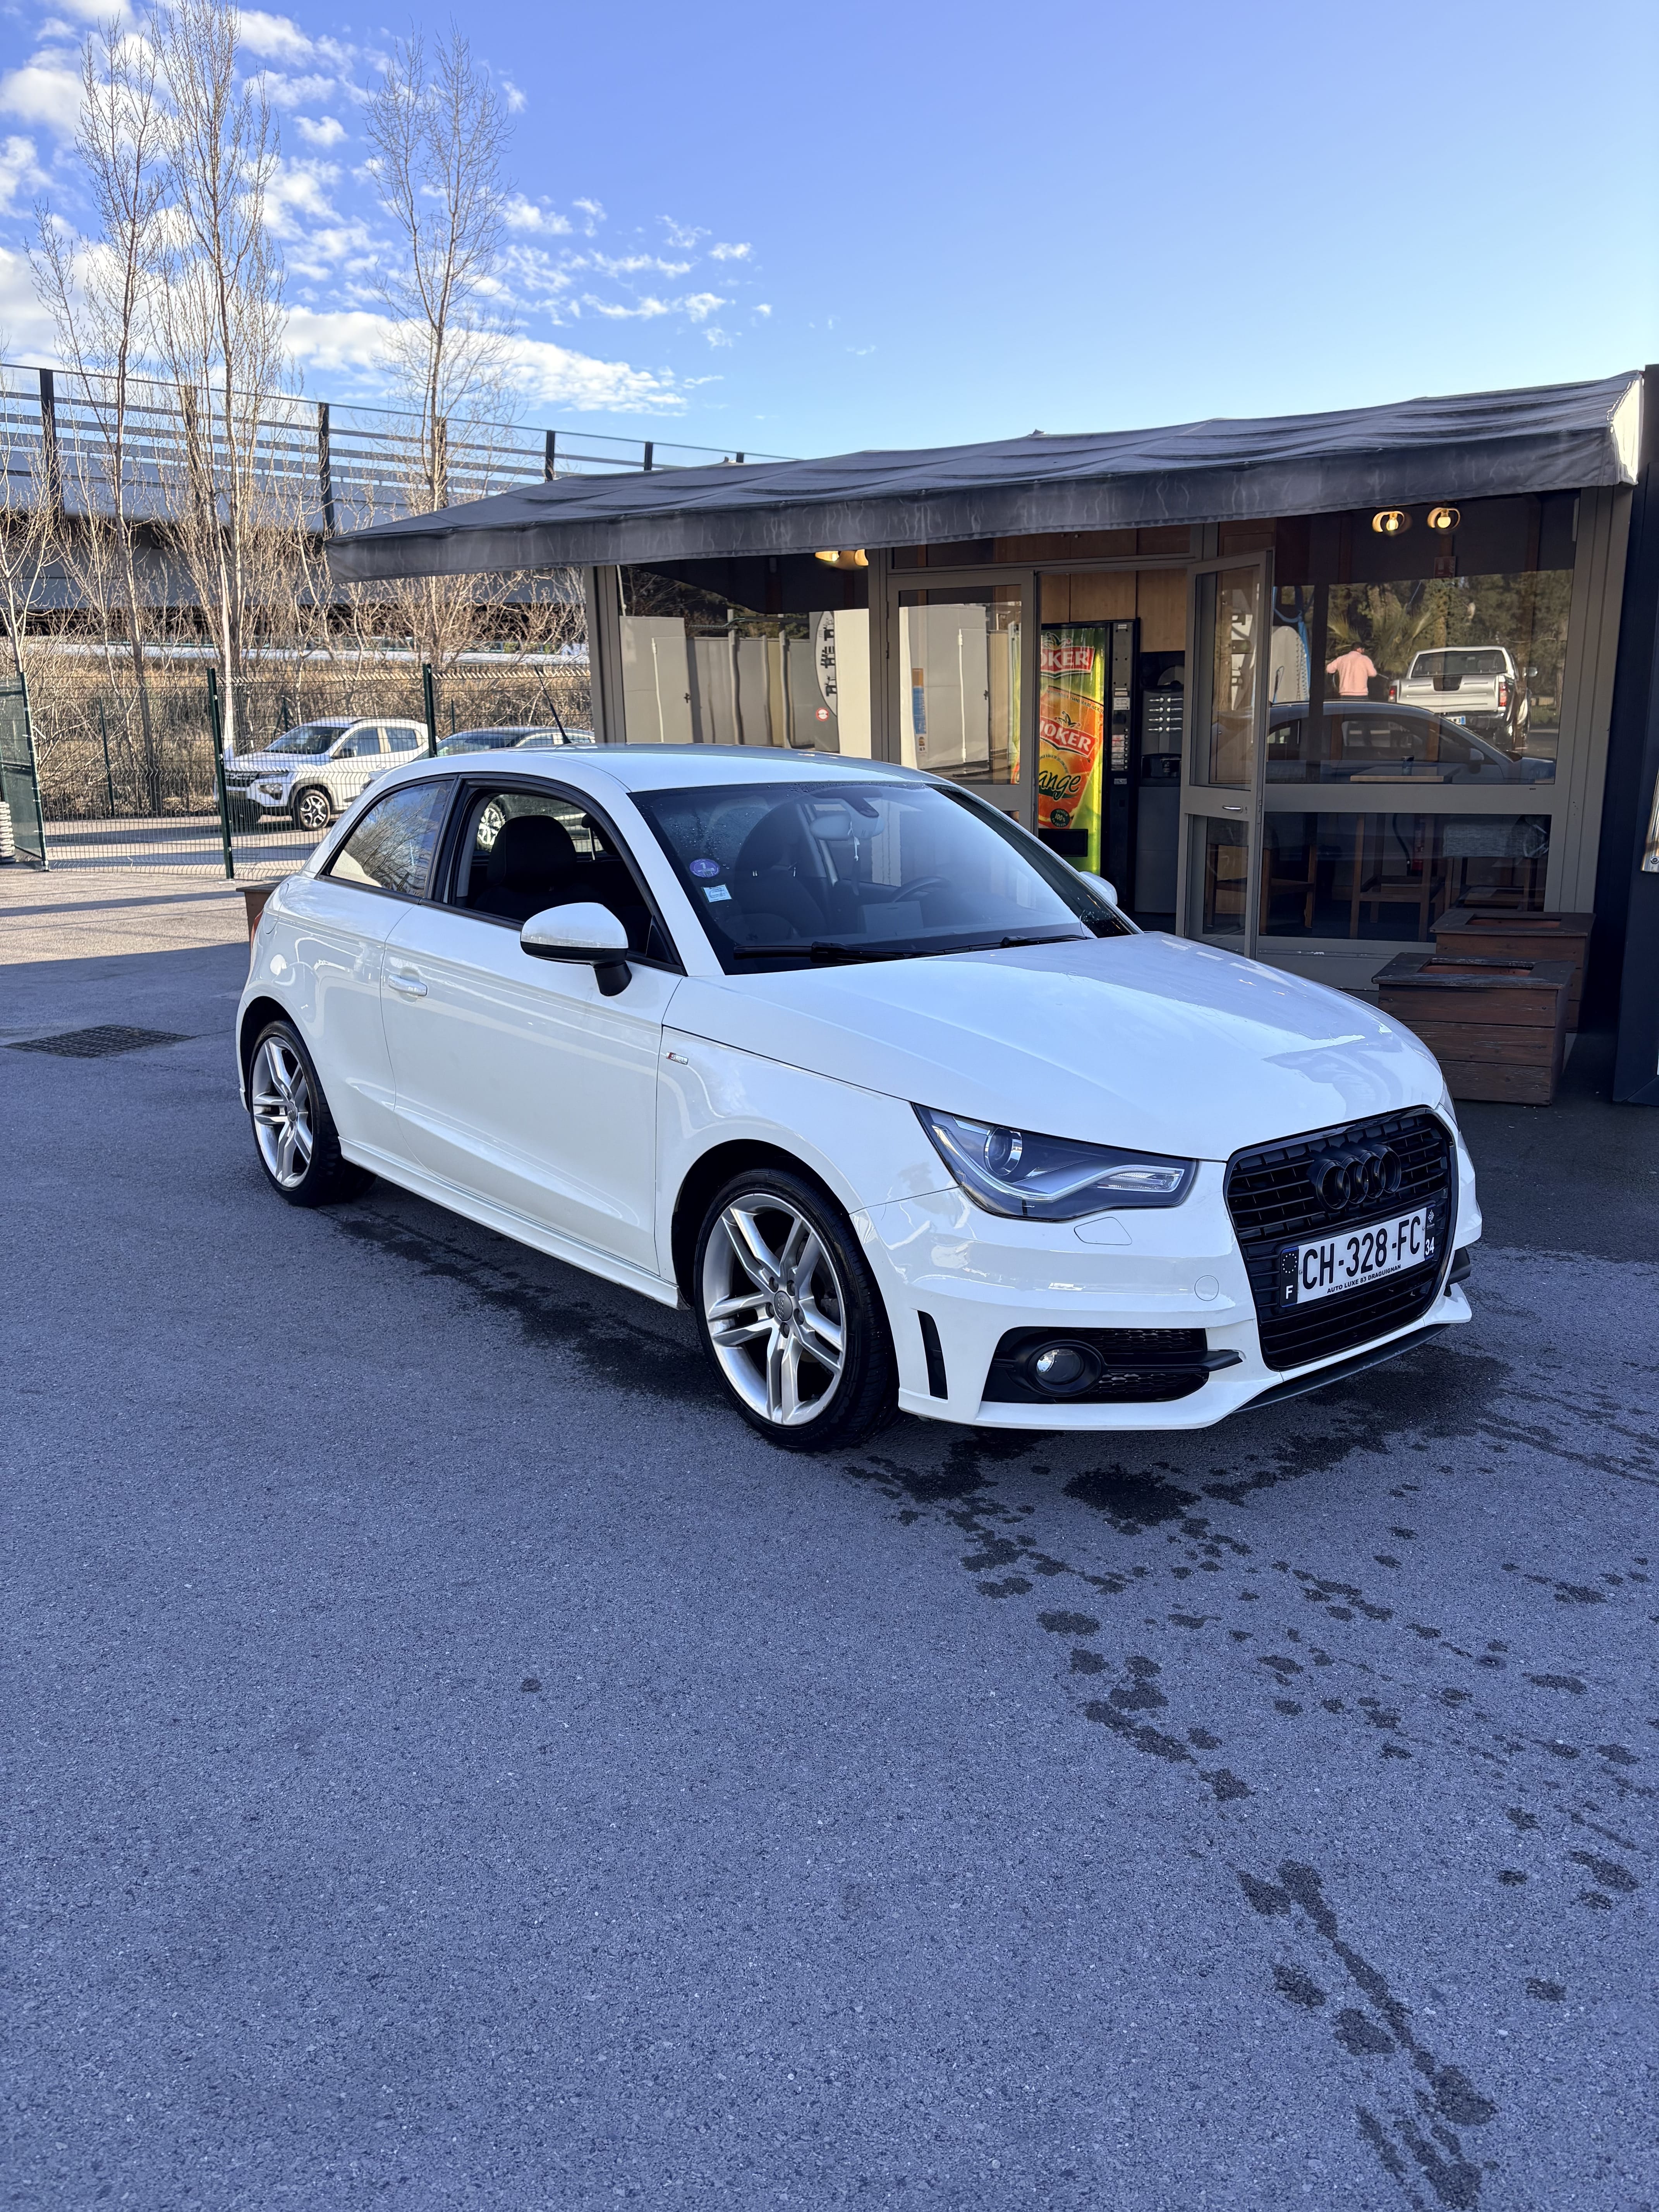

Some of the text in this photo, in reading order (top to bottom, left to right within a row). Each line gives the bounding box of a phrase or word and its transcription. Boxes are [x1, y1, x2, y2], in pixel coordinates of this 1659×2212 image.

[1302, 1216, 1421, 1290] CH-328-FC
[1425, 1237, 1434, 1255] 34
[1327, 1284, 1343, 1294] AUTO
[1344, 1279, 1359, 1288] LUXE
[1368, 1264, 1401, 1281] DRAGUIGNAN
[1286, 1285, 1293, 1299] F
